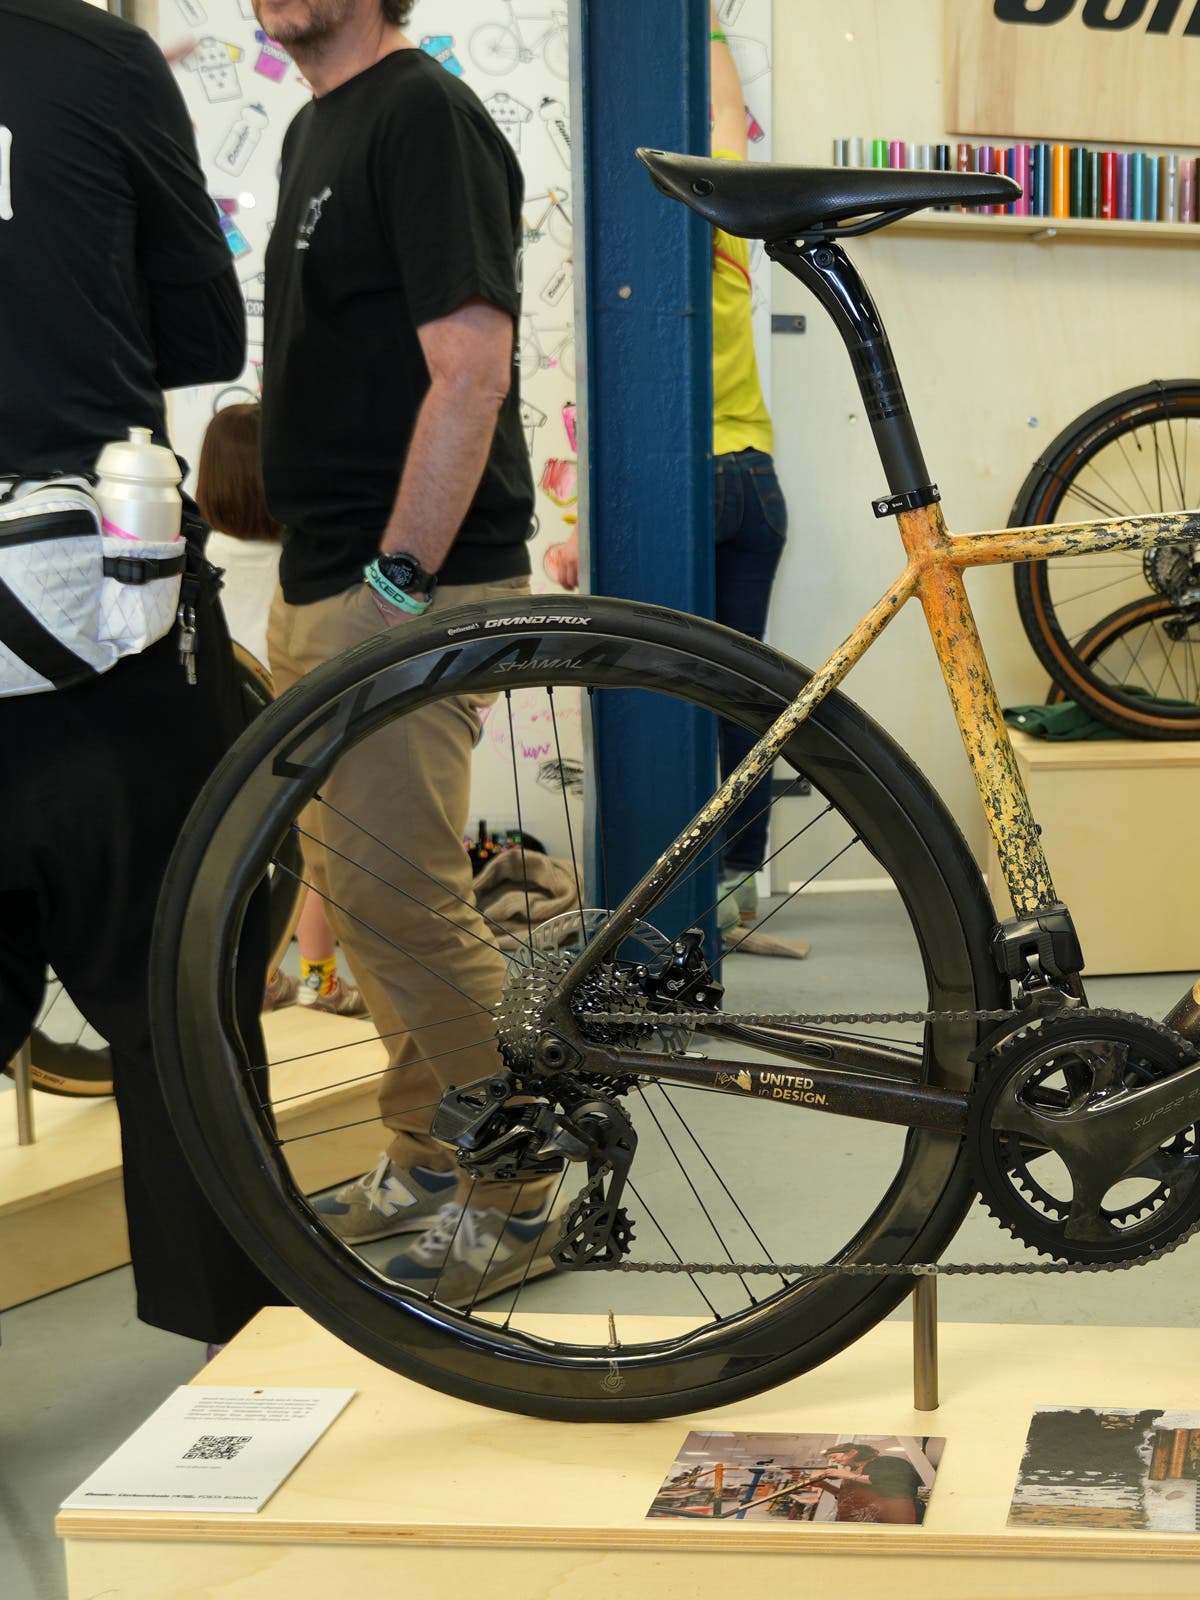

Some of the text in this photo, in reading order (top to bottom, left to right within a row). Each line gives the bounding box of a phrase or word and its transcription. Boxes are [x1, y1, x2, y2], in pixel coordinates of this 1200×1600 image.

[484, 615, 543, 629] GRAND
[546, 615, 592, 626] PRIX
[494, 658, 583, 673] SHAMAL
[760, 1071, 814, 1090] UNITED
[772, 1087, 829, 1106] DESIGN.
[1133, 1096, 1185, 1131] SUPER
